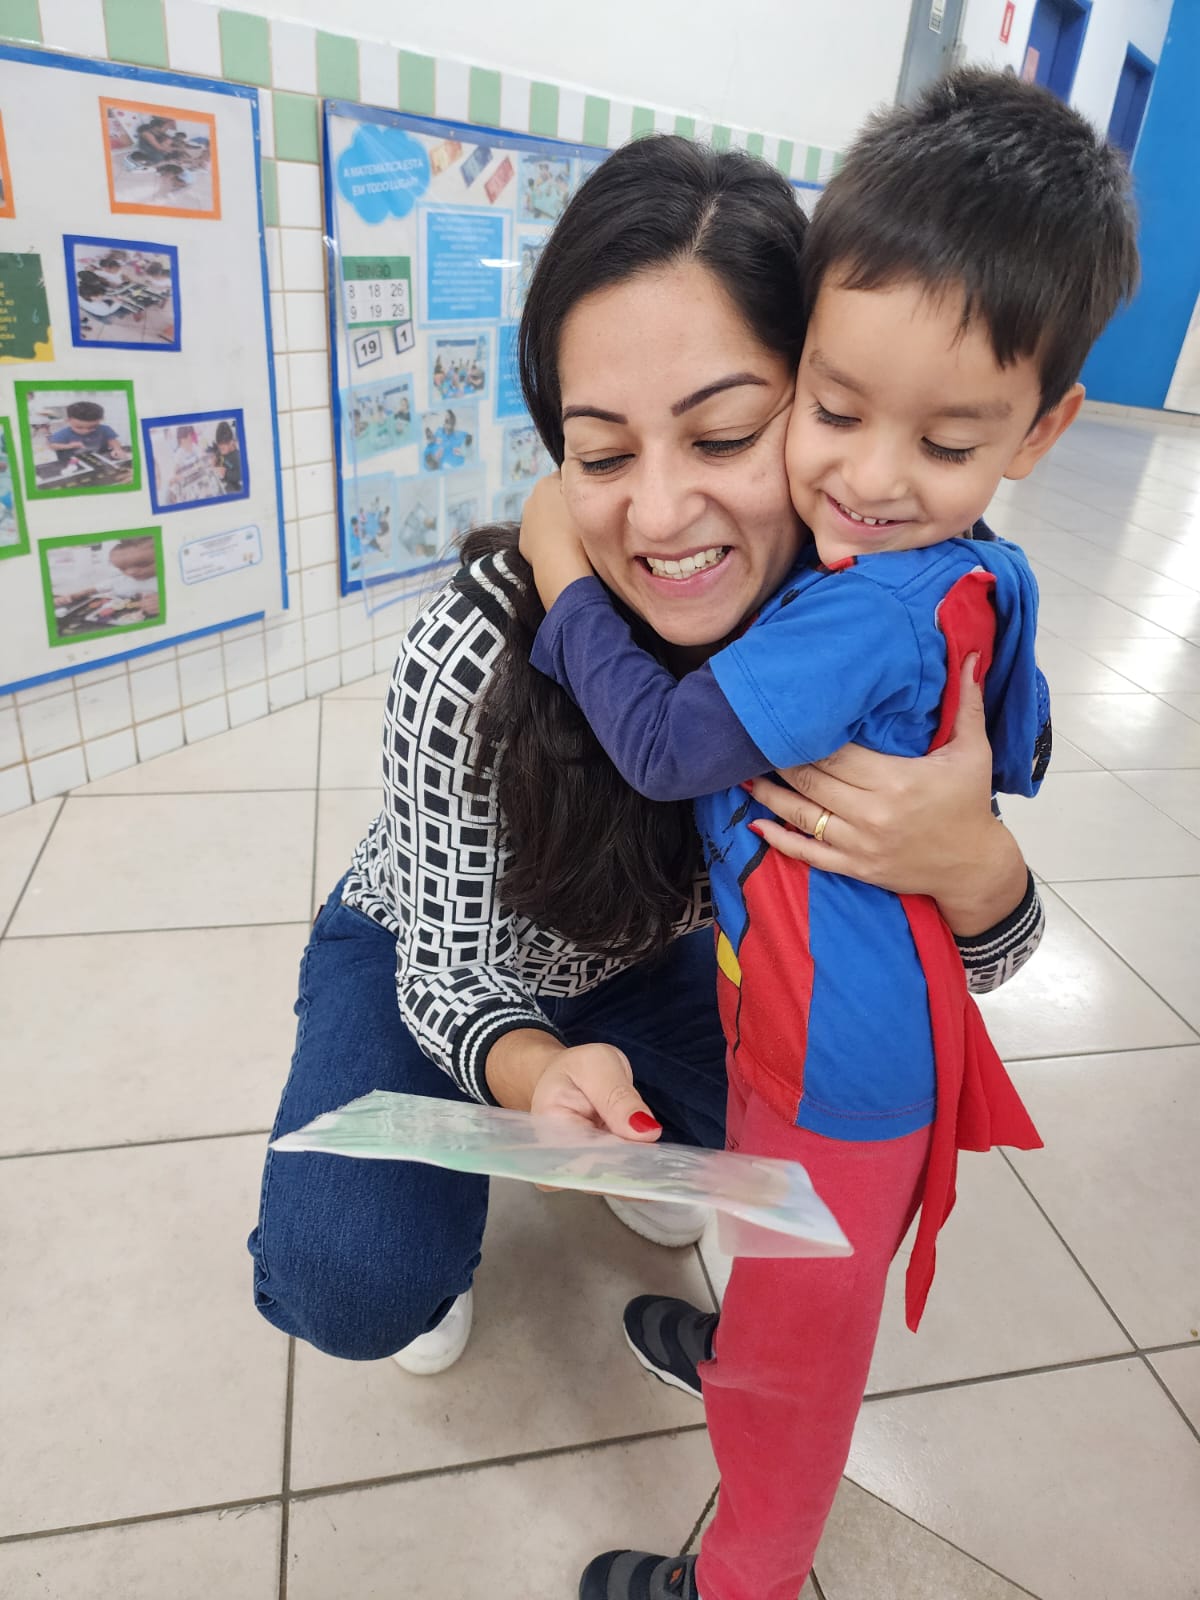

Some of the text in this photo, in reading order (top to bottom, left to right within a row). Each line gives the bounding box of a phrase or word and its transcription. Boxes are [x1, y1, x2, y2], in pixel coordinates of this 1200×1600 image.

[367, 180, 389, 194] TODO
[368, 283, 381, 299] 18
[350, 305, 358, 321] 9
[369, 303, 383, 320] 19
[400, 329, 408, 344] 1
[360, 339, 378, 358] 19
